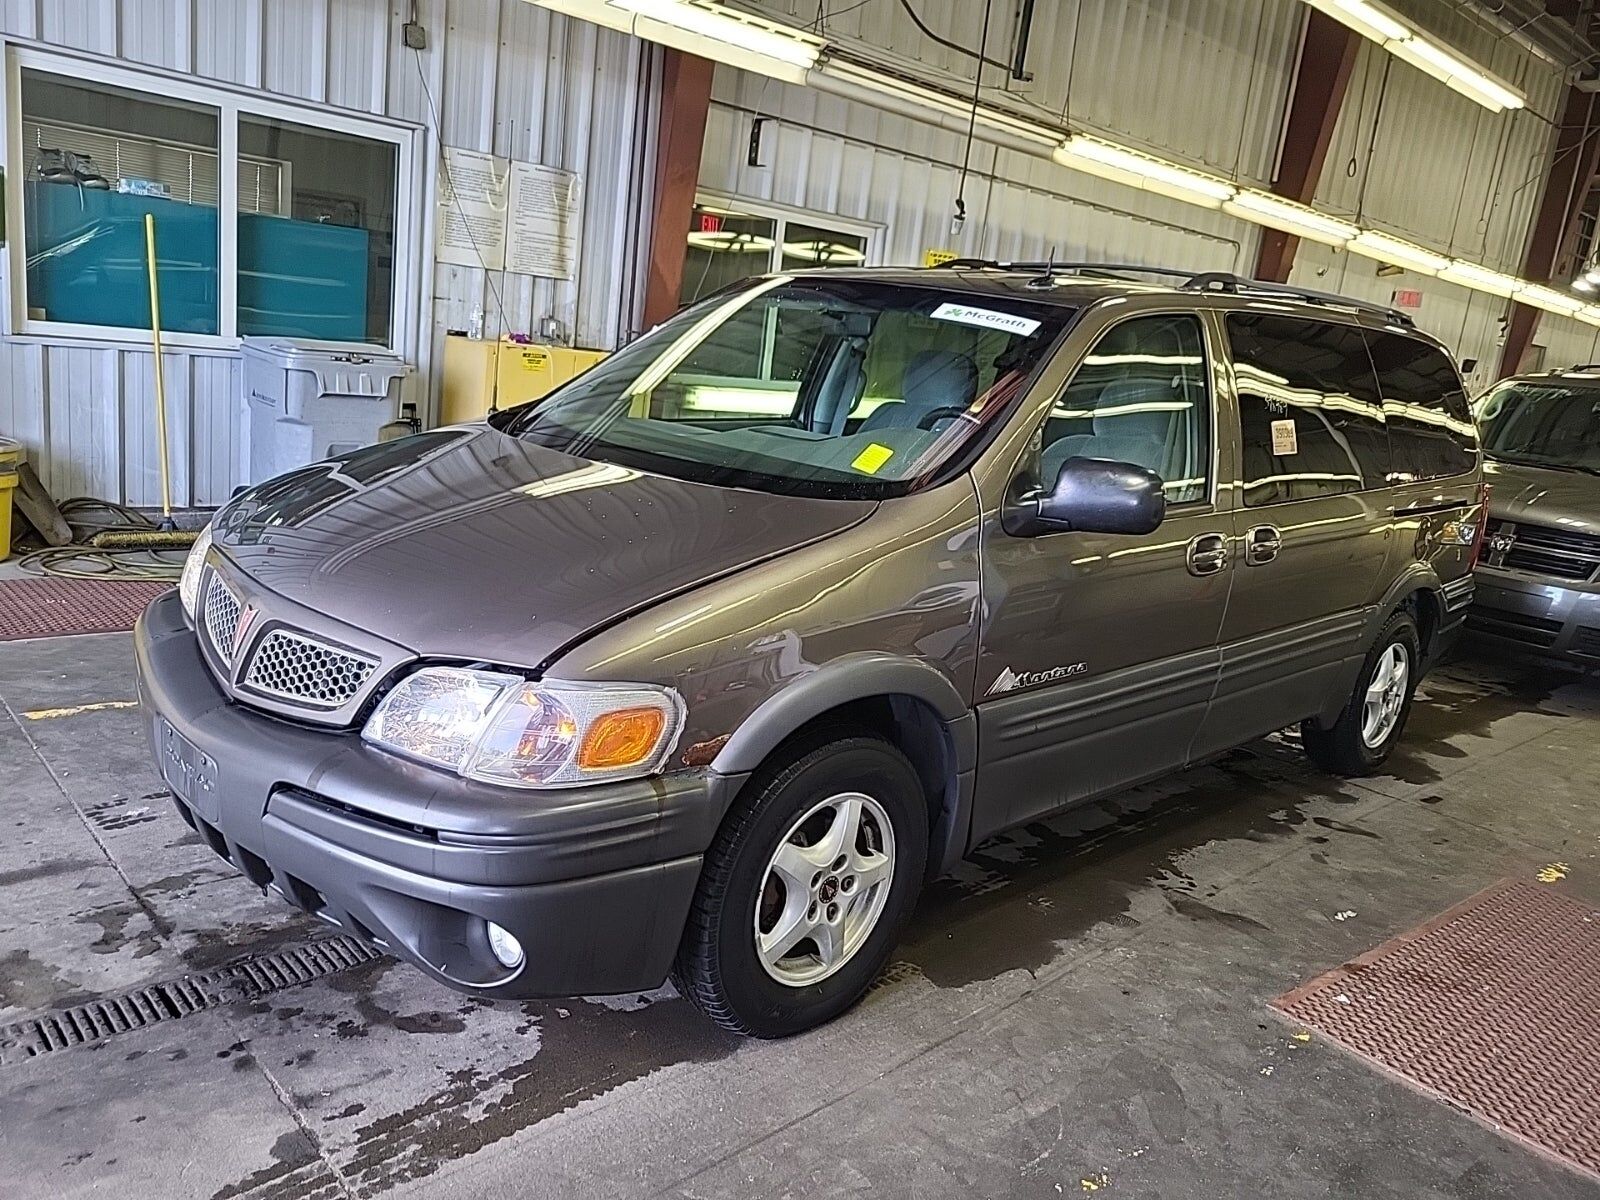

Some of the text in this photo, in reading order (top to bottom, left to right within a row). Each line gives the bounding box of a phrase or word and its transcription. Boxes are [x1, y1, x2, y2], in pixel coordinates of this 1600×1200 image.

[702, 215, 719, 232] EXIT
[964, 310, 1026, 328] McGrath
[1012, 662, 1088, 688] Montana
[165, 741, 216, 791] PONTAC
